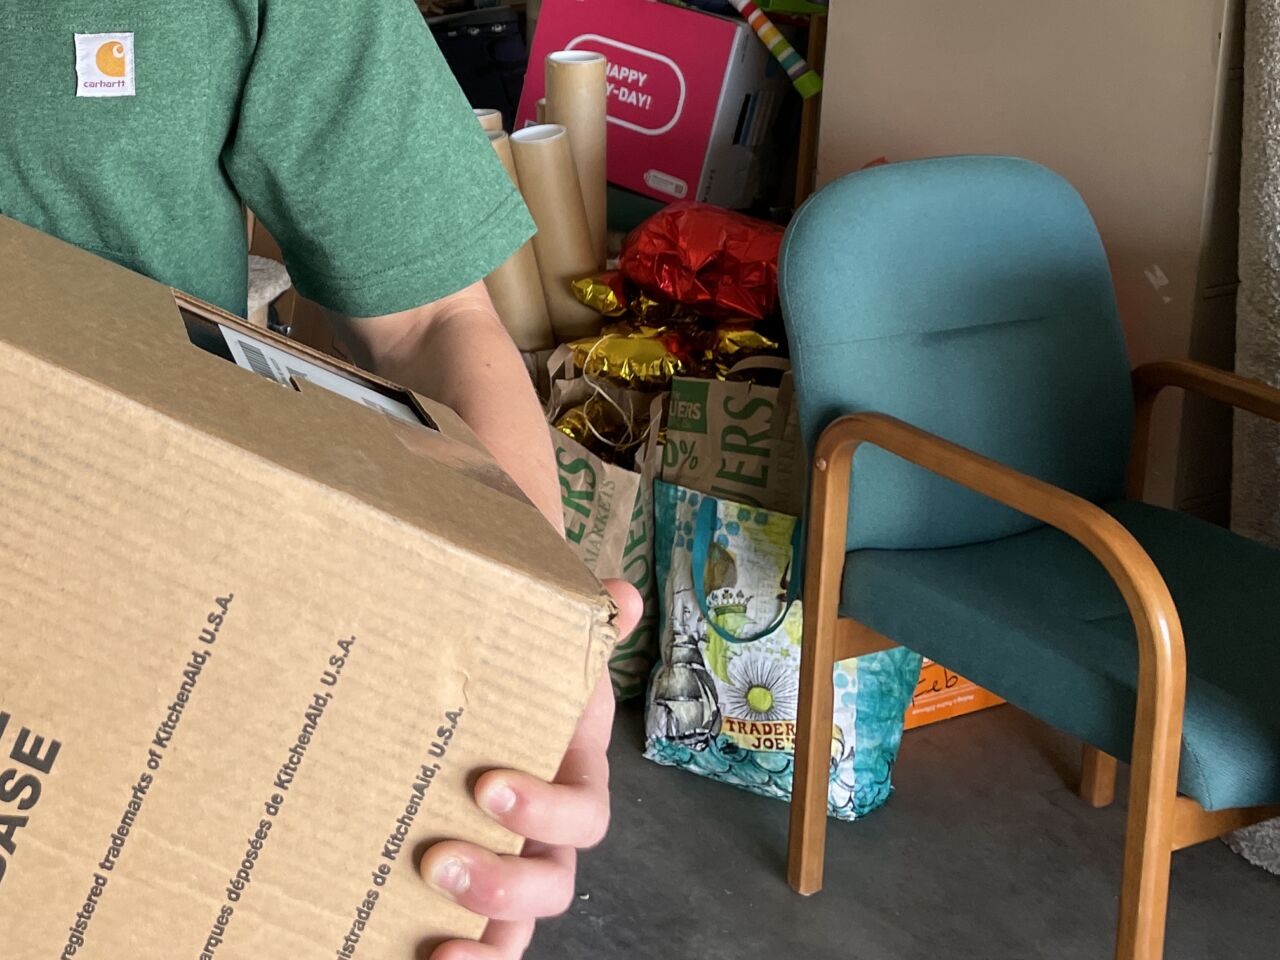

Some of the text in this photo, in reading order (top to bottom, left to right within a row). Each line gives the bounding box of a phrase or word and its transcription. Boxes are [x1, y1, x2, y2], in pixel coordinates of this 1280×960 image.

[83, 80, 125, 88] carhartt
[320, 635, 357, 687] U.S.A.
[274, 692, 334, 791] KitchenAid,
[726, 718, 795, 736] TRADER
[61, 592, 234, 960] registered trademarks of KitchenAid, U.S.A.
[265, 793, 285, 817] de
[373, 863, 391, 887] de
[382, 763, 441, 861] KitchenAid,
[428, 706, 464, 758] U.S.A.
[226, 818, 272, 903] déposées
